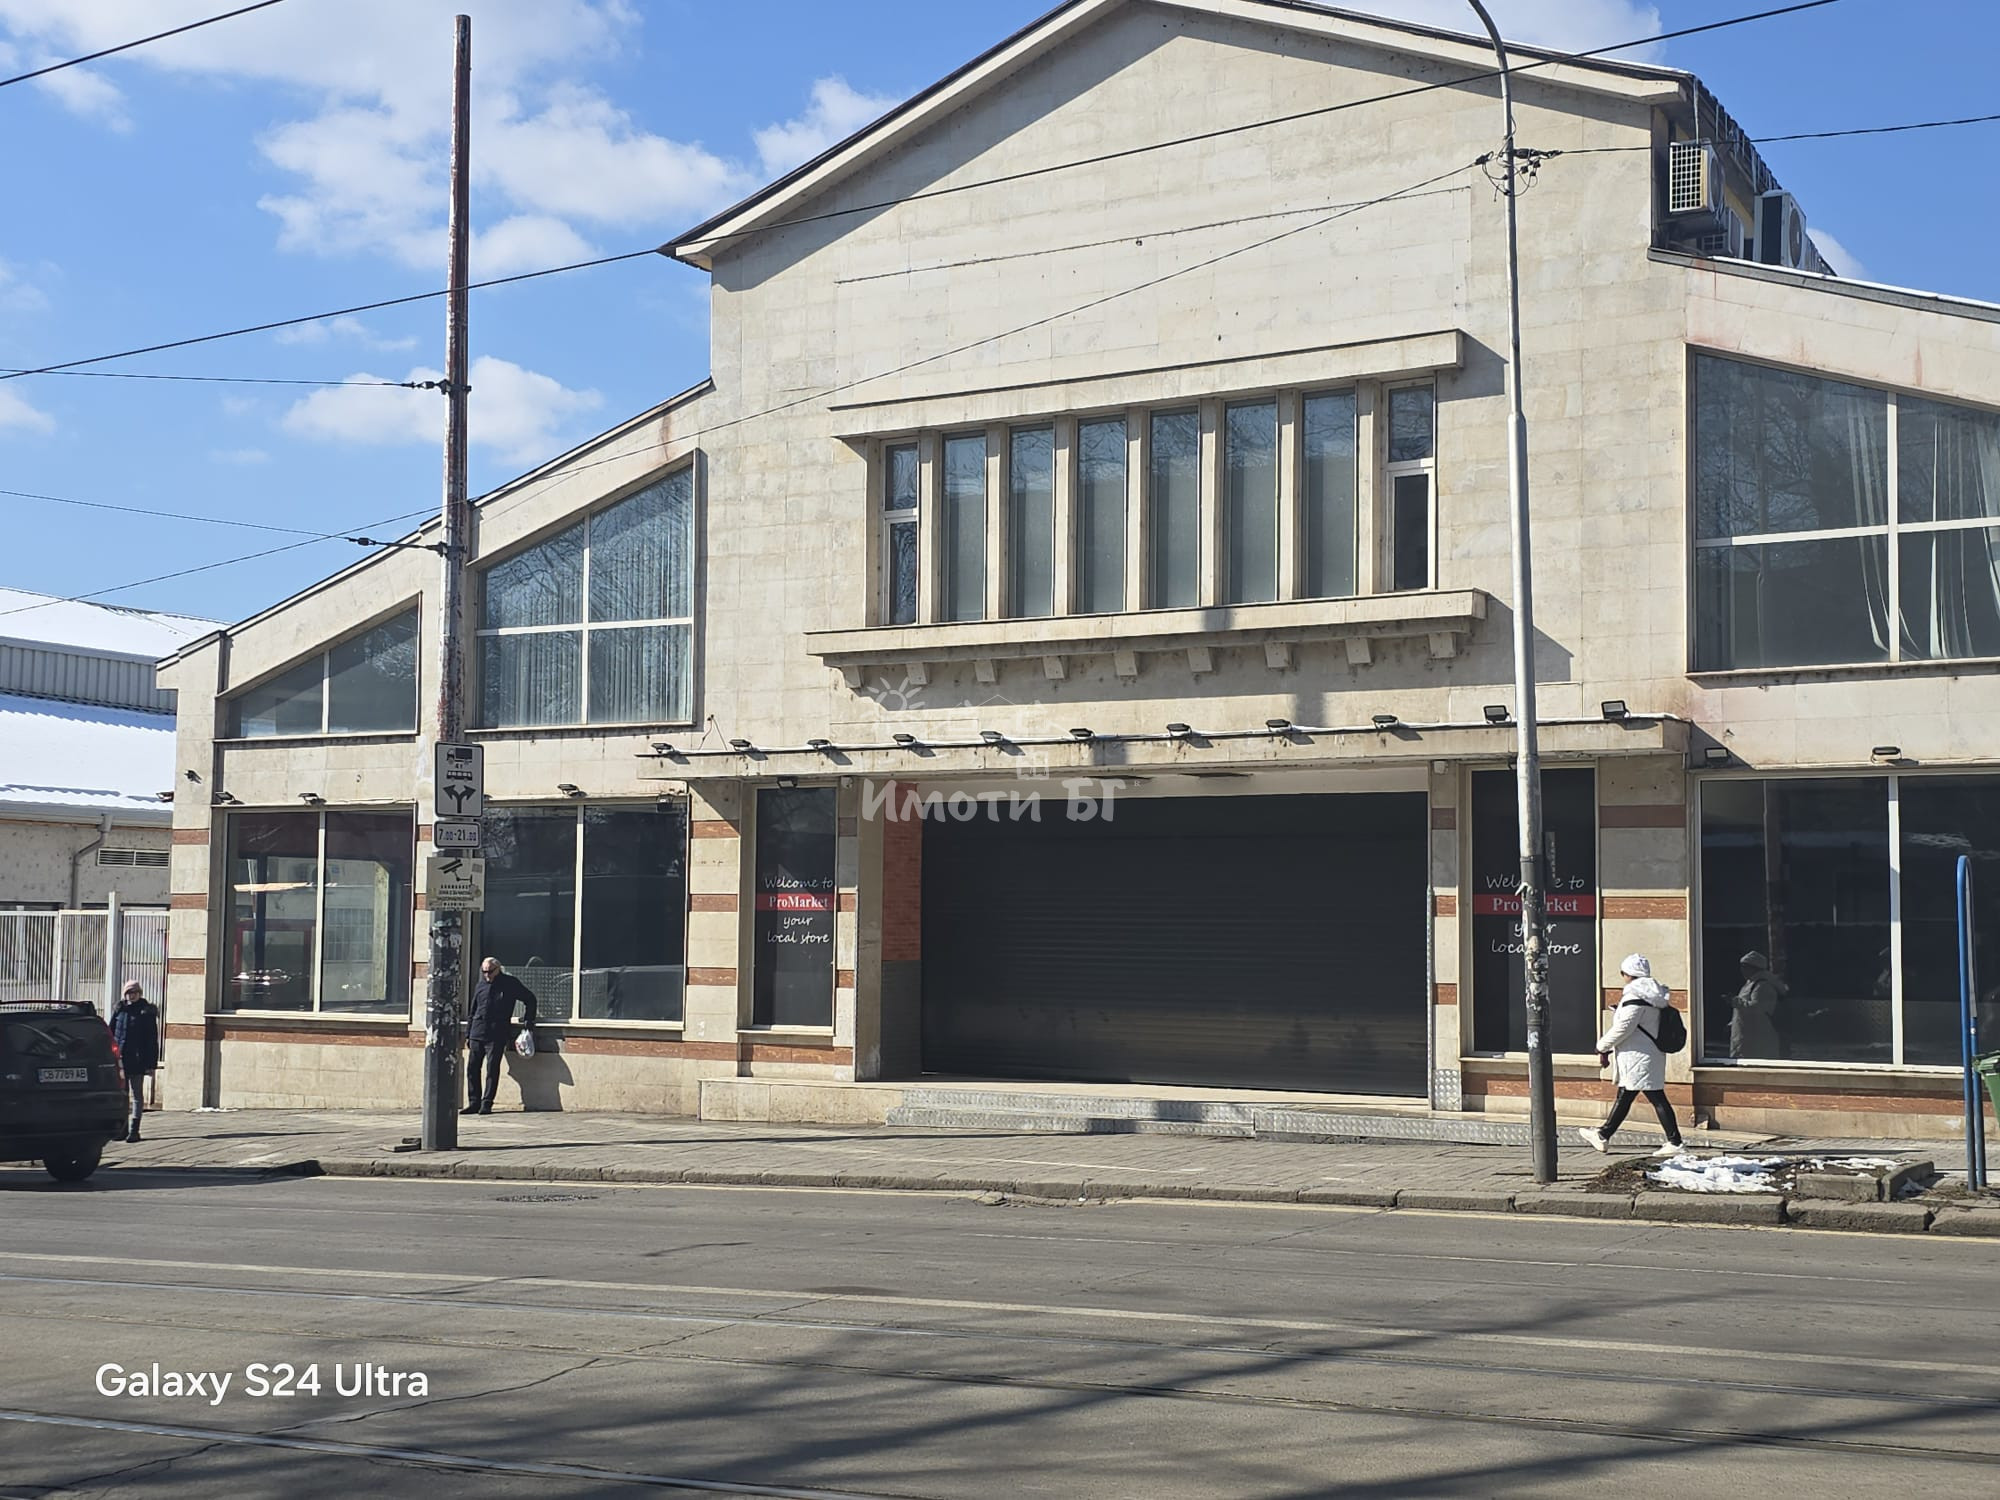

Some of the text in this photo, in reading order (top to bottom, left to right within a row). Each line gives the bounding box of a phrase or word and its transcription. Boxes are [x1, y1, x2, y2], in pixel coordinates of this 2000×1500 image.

[765, 875, 834, 889] Welcome to
[1486, 873, 1585, 890] Wele to
[769, 895, 828, 908] ProMarket
[1493, 898, 1578, 912] Prorket
[783, 916, 813, 929] your
[768, 930, 830, 944] local store
[1514, 923, 1557, 937] yr
[1491, 938, 1582, 955] loca tore
